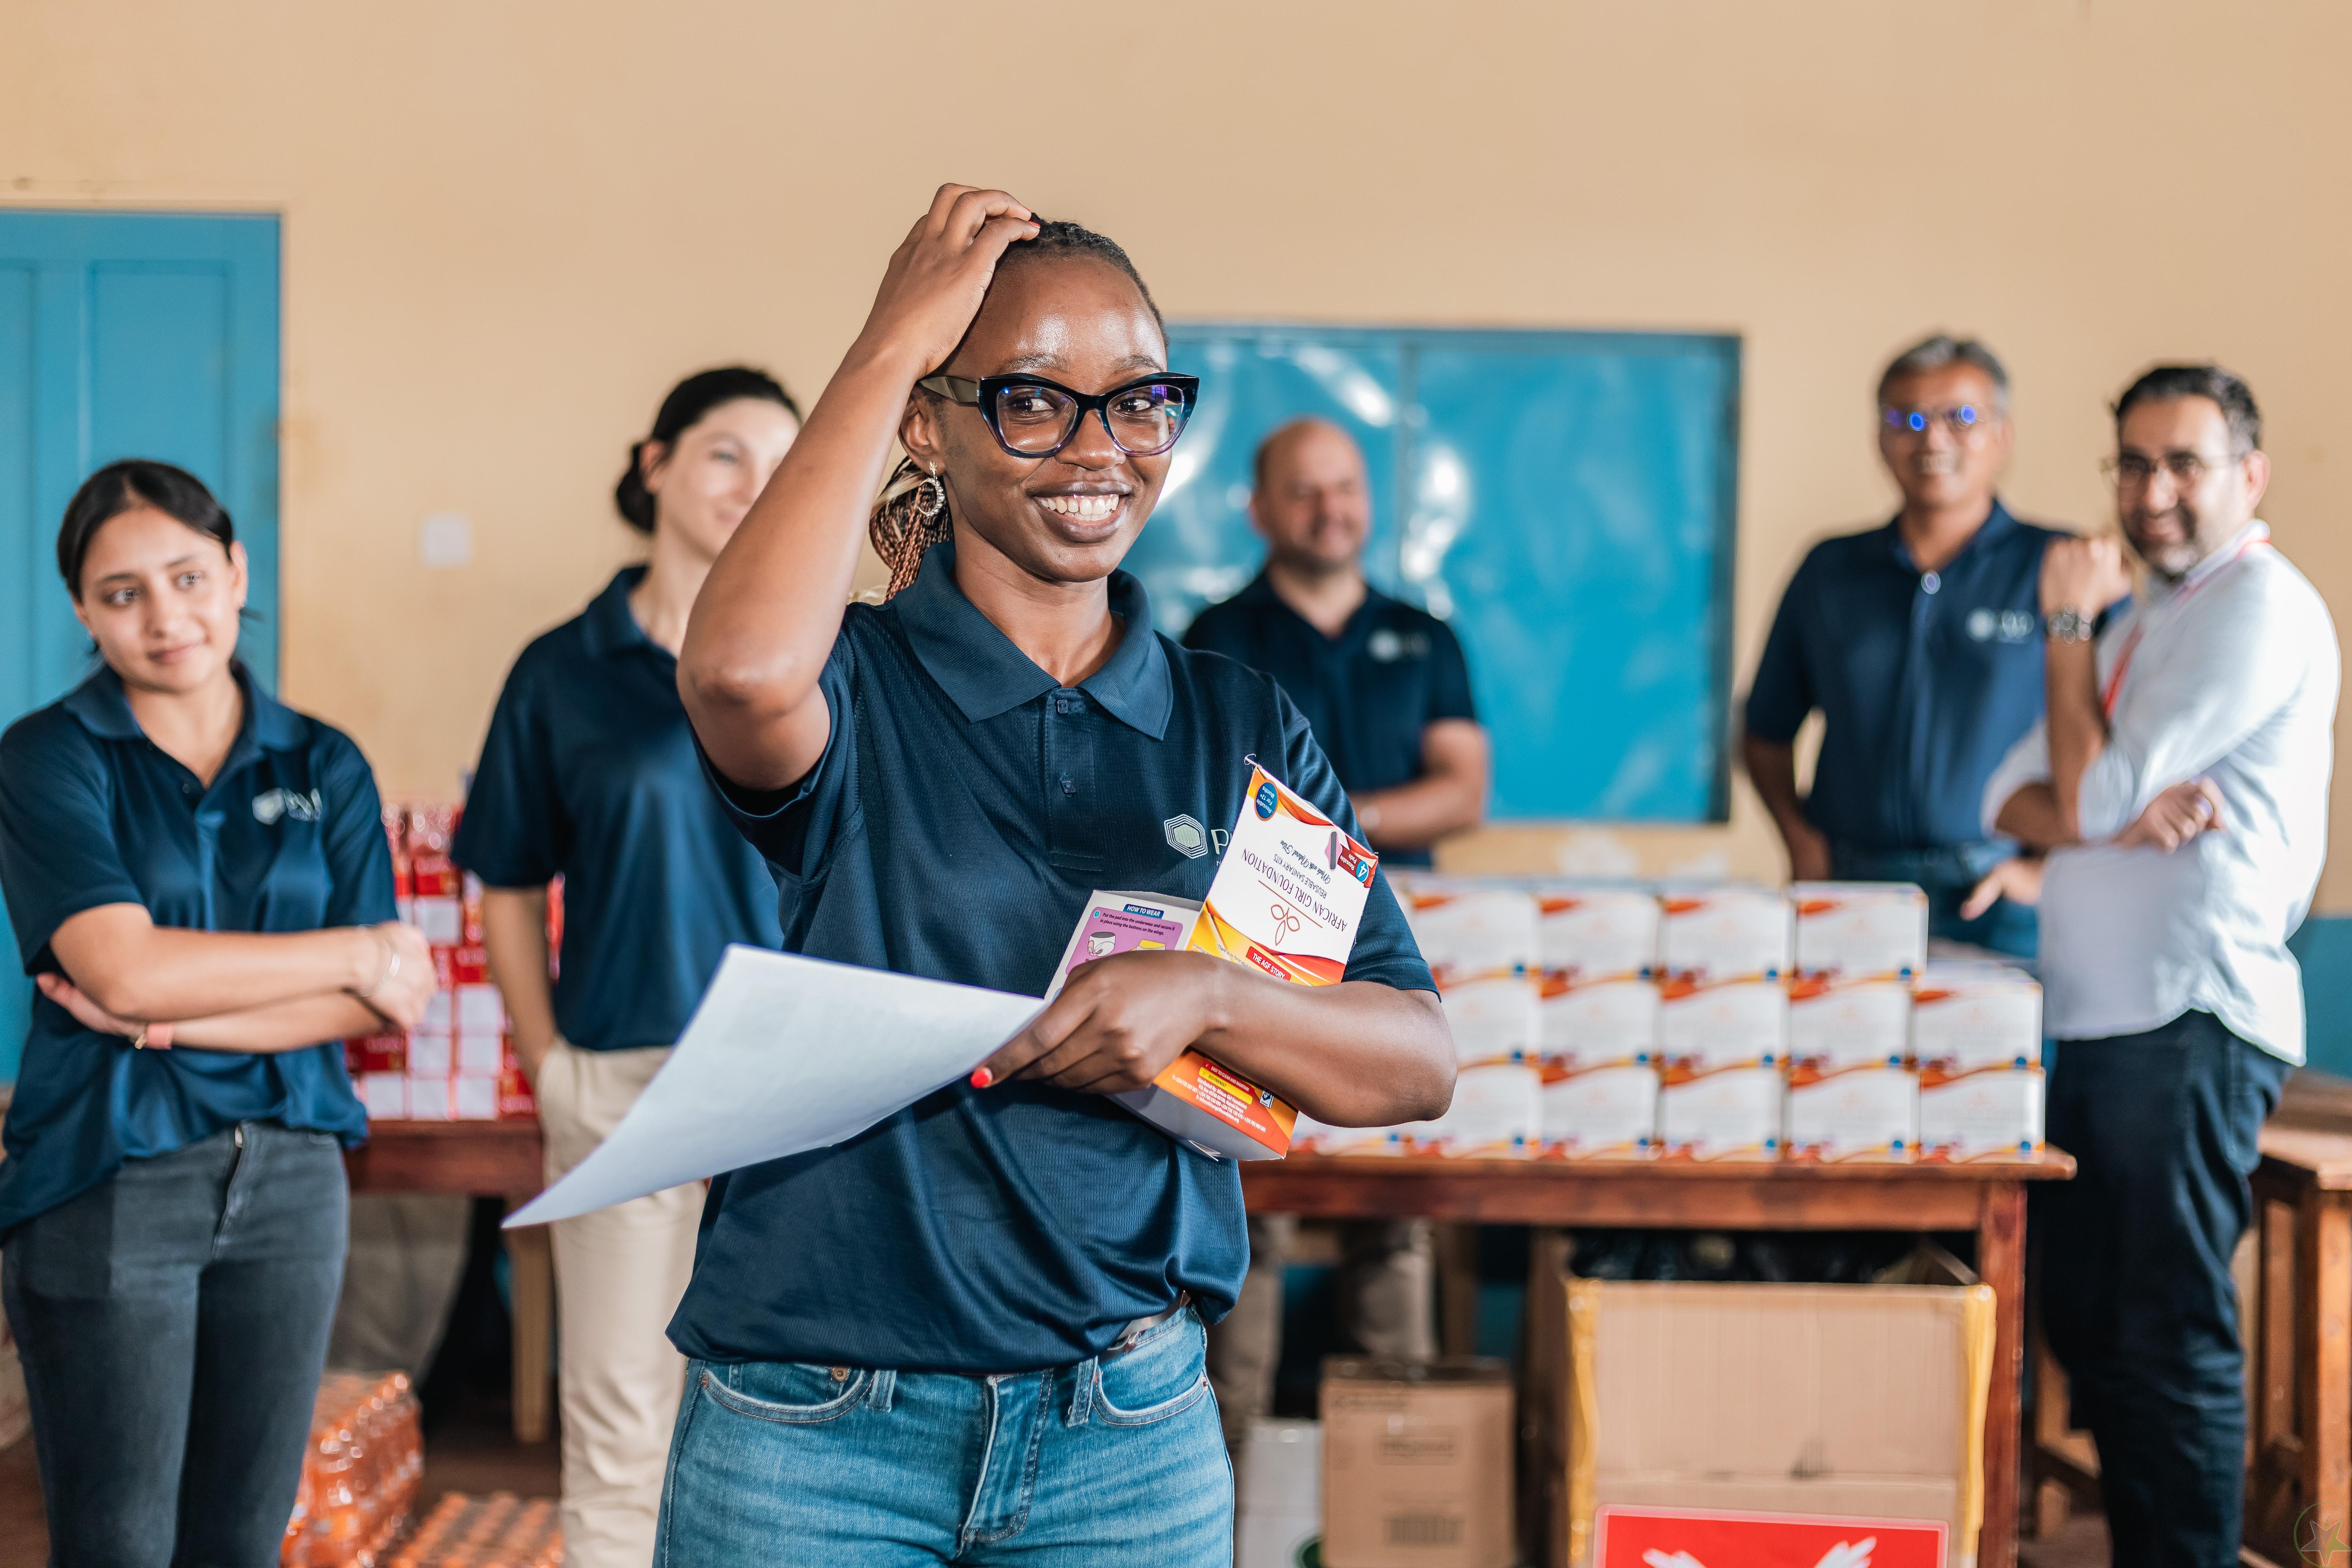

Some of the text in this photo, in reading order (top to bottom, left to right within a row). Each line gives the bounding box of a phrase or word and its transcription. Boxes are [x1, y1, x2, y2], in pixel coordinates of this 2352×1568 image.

[1262, 786, 1275, 799] Months
[1256, 799, 1272, 814] Reusable
[1280, 840, 1293, 854] Fibre
[1292, 850, 1309, 867] Natural
[1340, 855, 1355, 871] Reusable
[1348, 854, 1357, 864] Pads
[1274, 854, 1327, 898] REUSABLE SANITARY KITS
[1317, 867, 1331, 884] Made
[1358, 864, 1367, 878] 4
[1242, 848, 1347, 932] AFRICAN GIRL FOUNDATION
[1253, 953, 1285, 979] THE AGF STORY
[1214, 1078, 1227, 1087] FRIENDLY
[1236, 1081, 1249, 1091] MAINTAIN
[1197, 1077, 1213, 1089] Distributed
[1217, 1088, 1227, 1098] African
[1232, 1097, 1247, 1109] Foundation
[1225, 1099, 1236, 1109] Nairobi
[1235, 1105, 1244, 1114] Kenya
